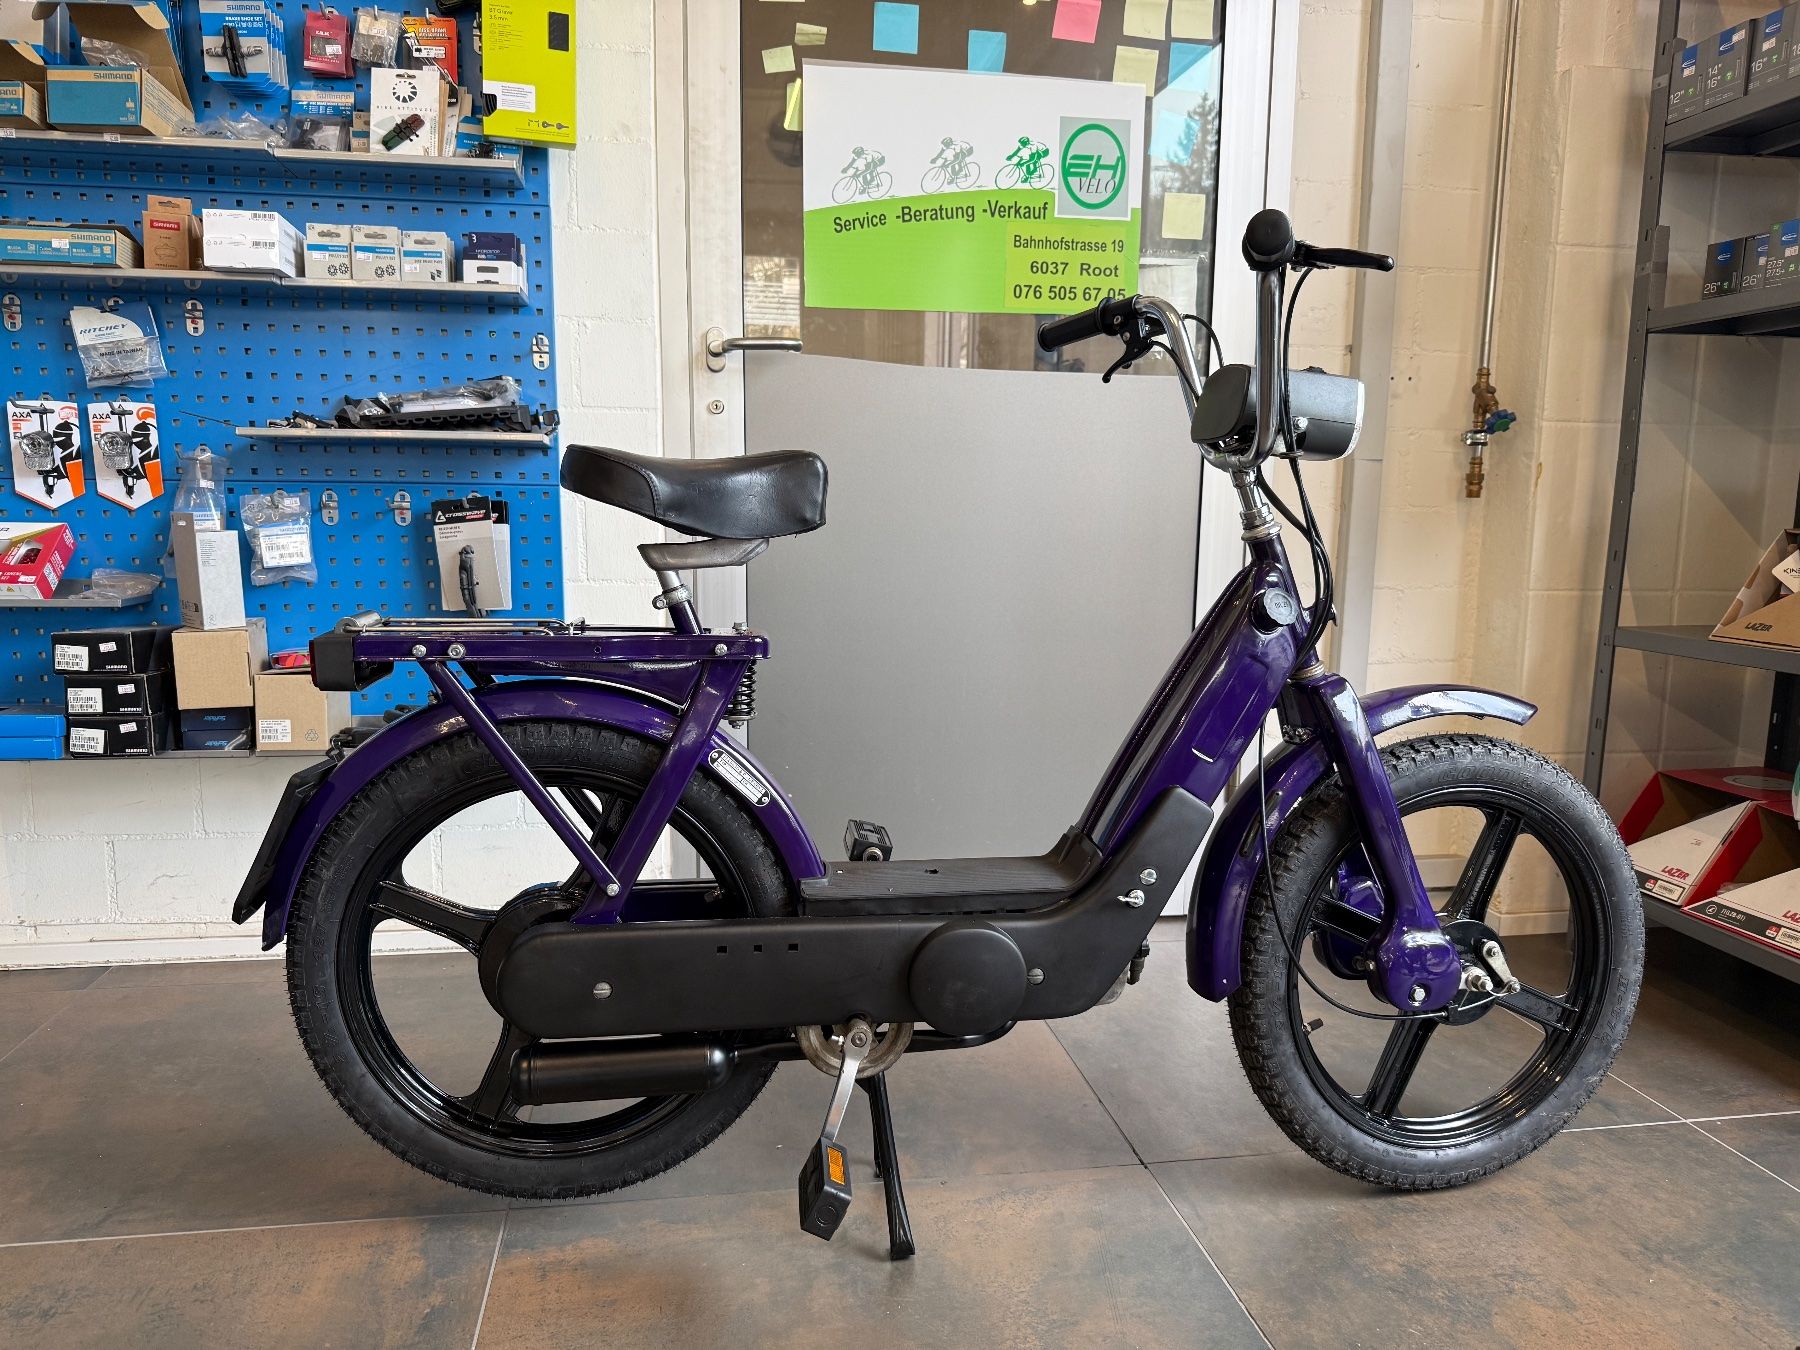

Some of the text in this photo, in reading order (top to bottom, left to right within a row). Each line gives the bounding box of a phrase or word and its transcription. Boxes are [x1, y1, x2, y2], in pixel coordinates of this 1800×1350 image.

[1079, 177, 1117, 194] VELO
[833, 199, 1049, 234] Service -Beratung -Verkauf
[71, 233, 111, 242] SHIMANO
[1013, 234, 1124, 253] Bahnhofstrasse 19
[1030, 260, 1119, 278] 6037 Root
[1013, 284, 1126, 302] 076 505 67 05
[79, 323, 128, 335] RITCHEY
[92, 412, 112, 420] AXA
[1744, 622, 1773, 632] LAZER
[1661, 865, 1690, 881] LAZER
